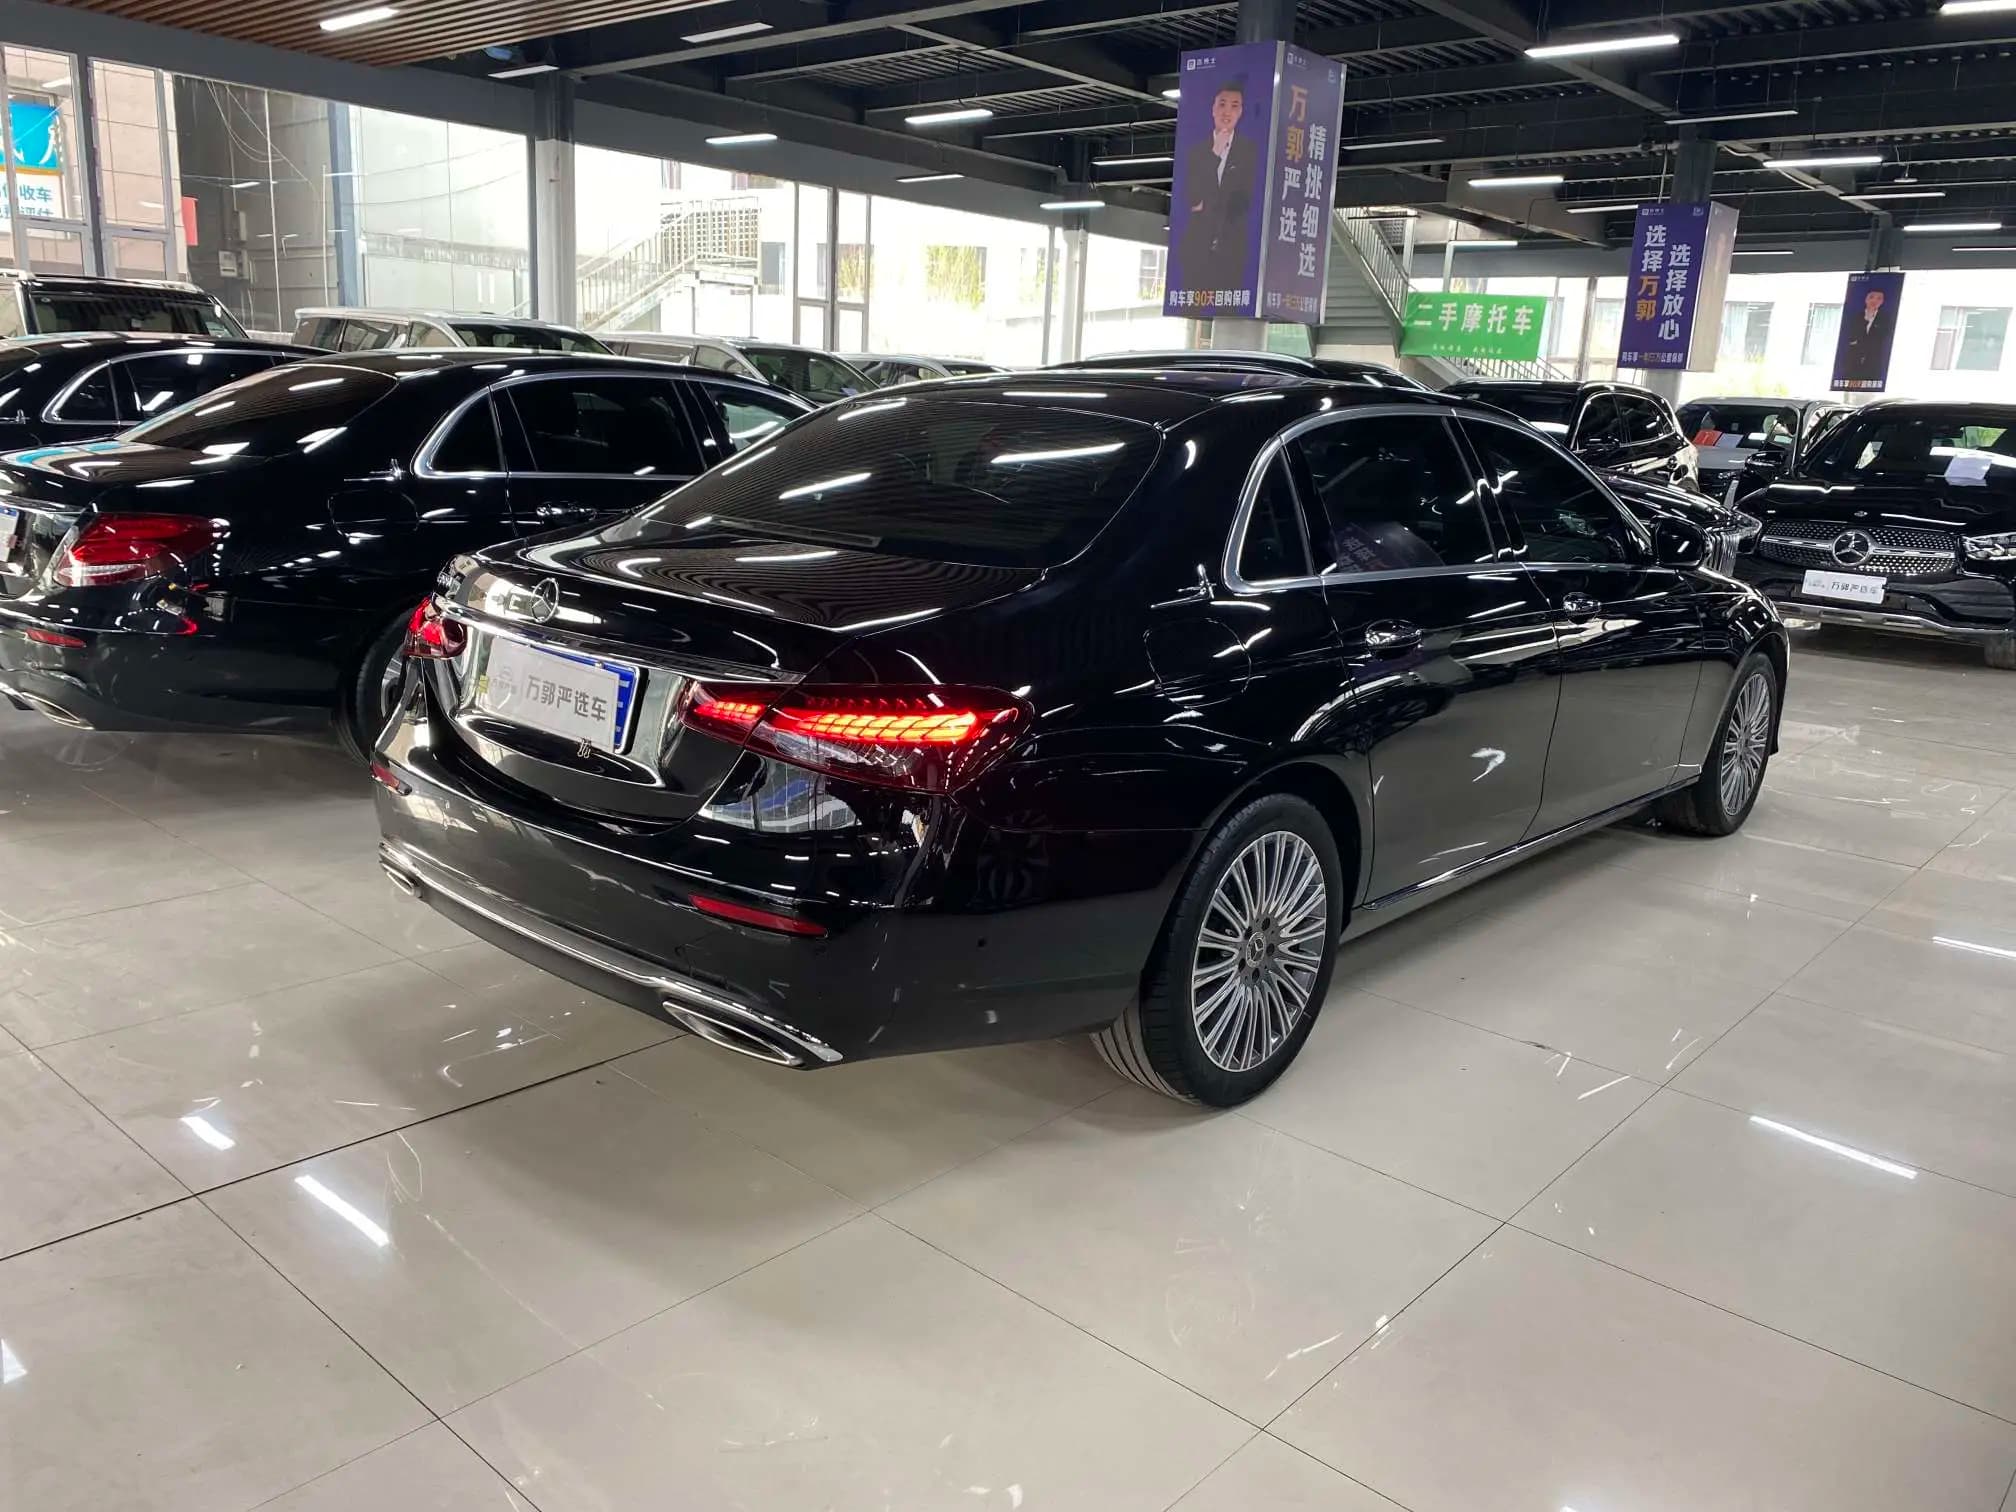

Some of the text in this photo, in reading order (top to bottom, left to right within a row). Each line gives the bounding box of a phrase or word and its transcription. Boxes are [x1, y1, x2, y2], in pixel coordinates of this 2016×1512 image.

[1278, 85, 1309, 243] 万郭严选
[1297, 123, 1328, 278] 精挑细选
[1168, 289, 1251, 307] 购车享90天回购保障
[1413, 302, 1534, 336] 二手摩托车
[1635, 225, 1667, 321] 选择万郭
[1658, 244, 1691, 341] 选择放心
[525, 675, 606, 721] 万郭严选车
